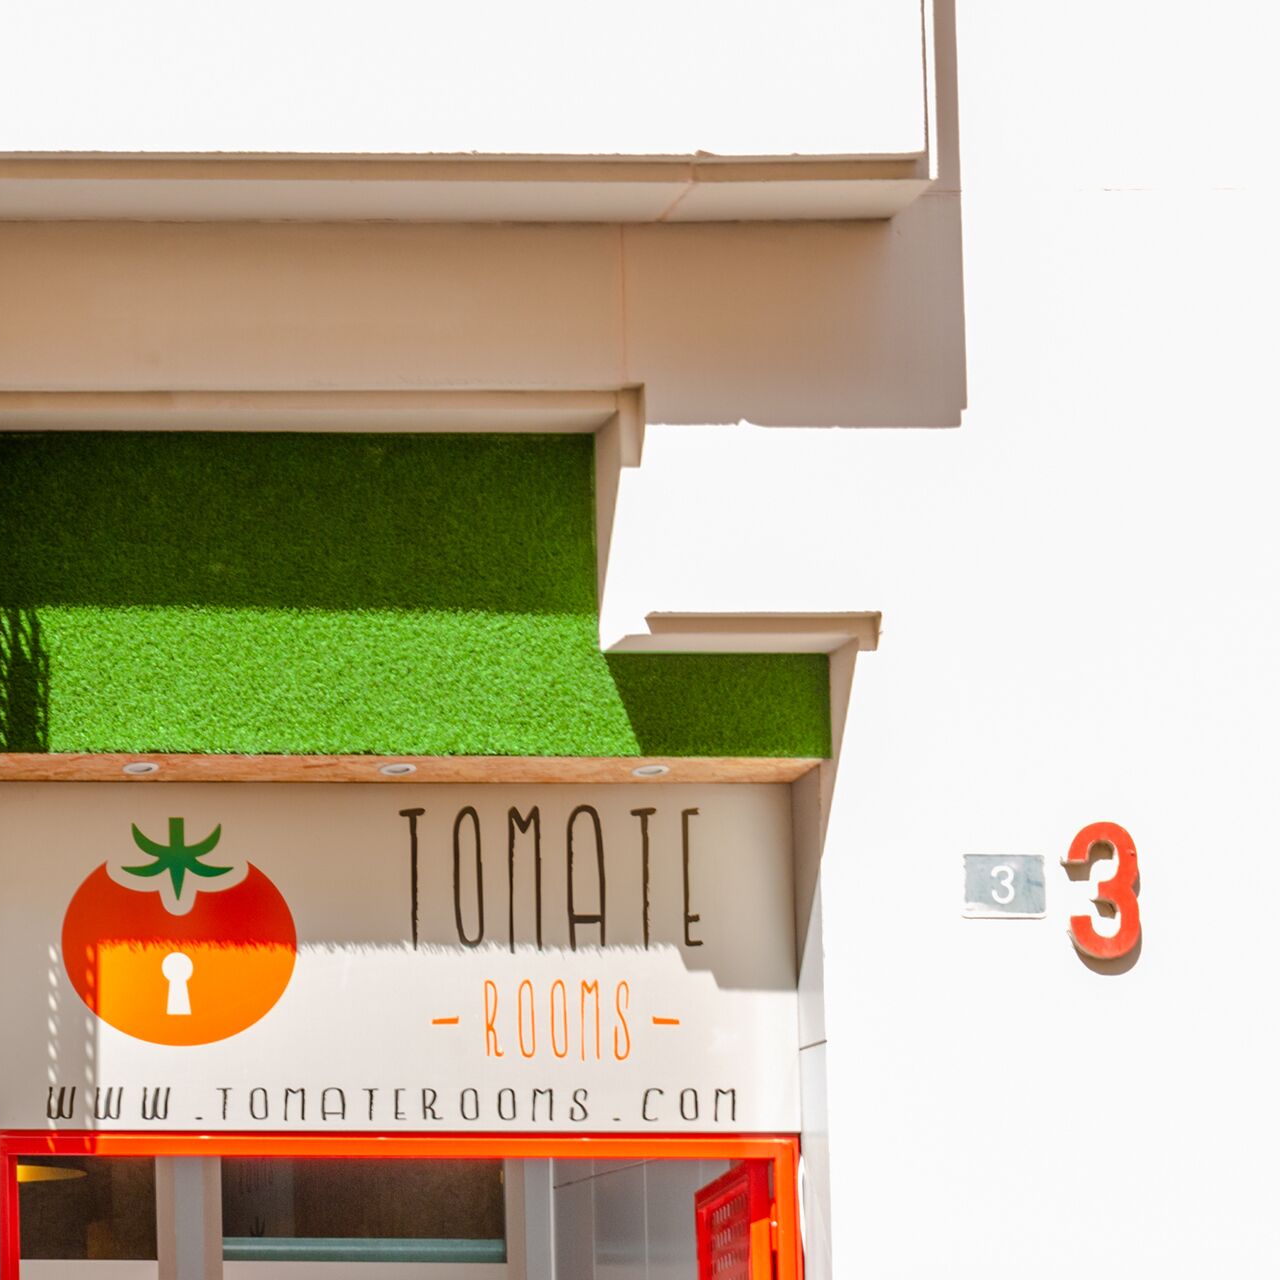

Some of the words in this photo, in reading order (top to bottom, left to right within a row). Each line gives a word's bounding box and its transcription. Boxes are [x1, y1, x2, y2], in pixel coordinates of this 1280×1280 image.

[399, 804, 705, 953] TOMATE
[990, 865, 1016, 906] 3
[1065, 821, 1142, 961] 3
[46, 1086, 739, 1121] WWW.TOMATEROOMS.COM
